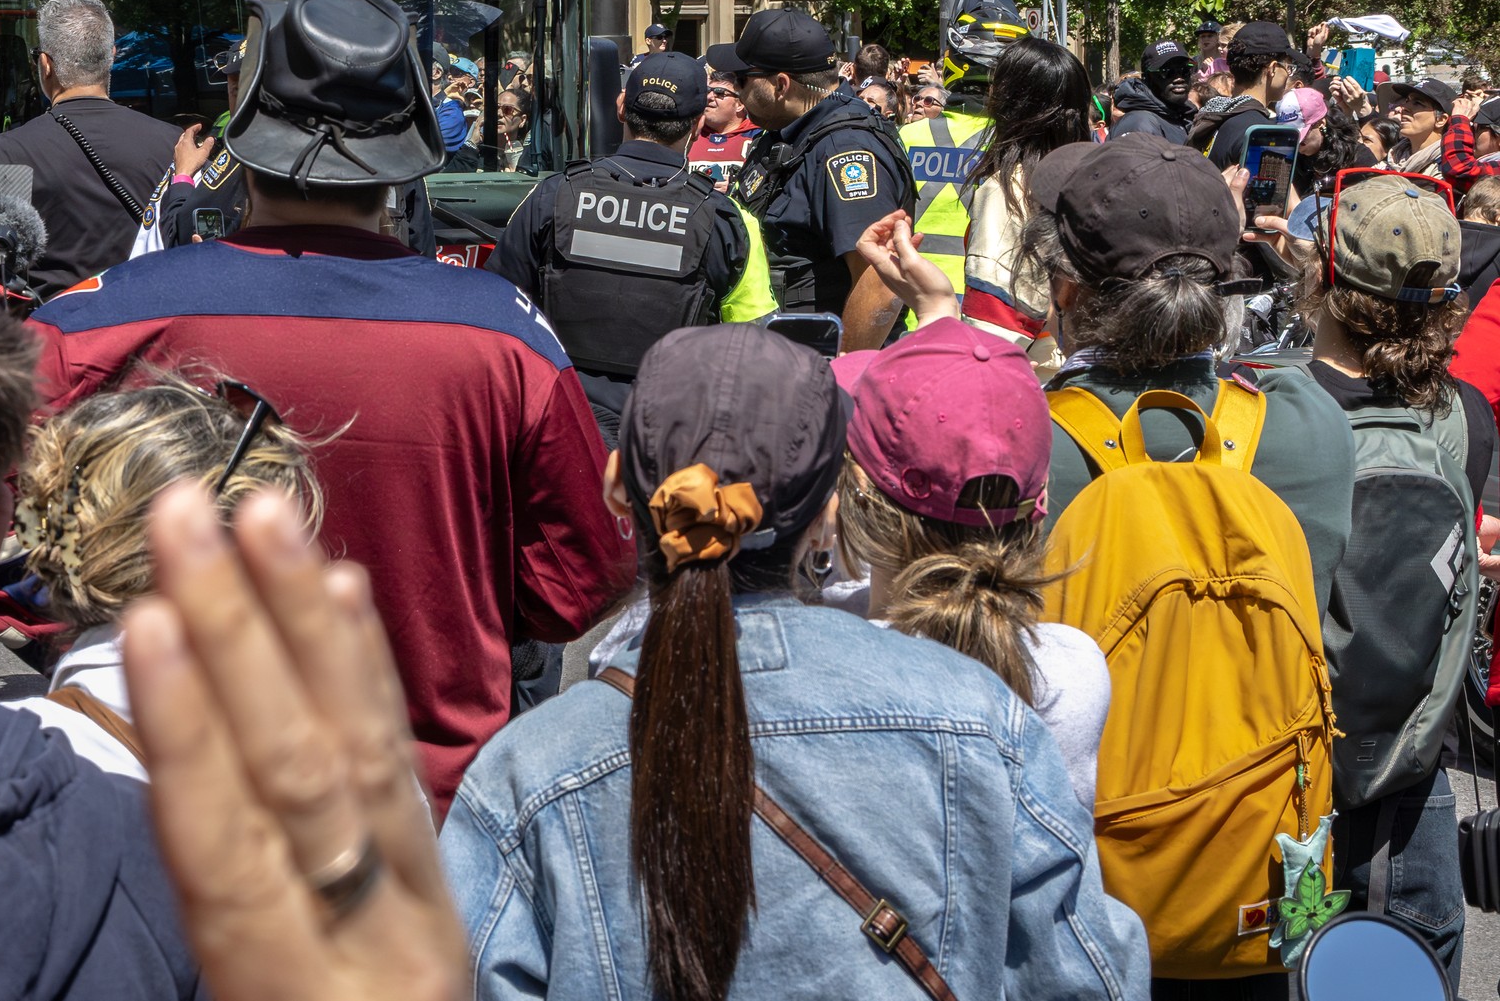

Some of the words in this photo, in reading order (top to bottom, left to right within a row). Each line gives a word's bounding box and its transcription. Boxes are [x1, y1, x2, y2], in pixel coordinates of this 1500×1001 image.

[642, 77, 678, 93] POLICE
[832, 154, 870, 169] POLICE
[848, 190, 868, 198] SPVM
[575, 191, 690, 236] POLICE
